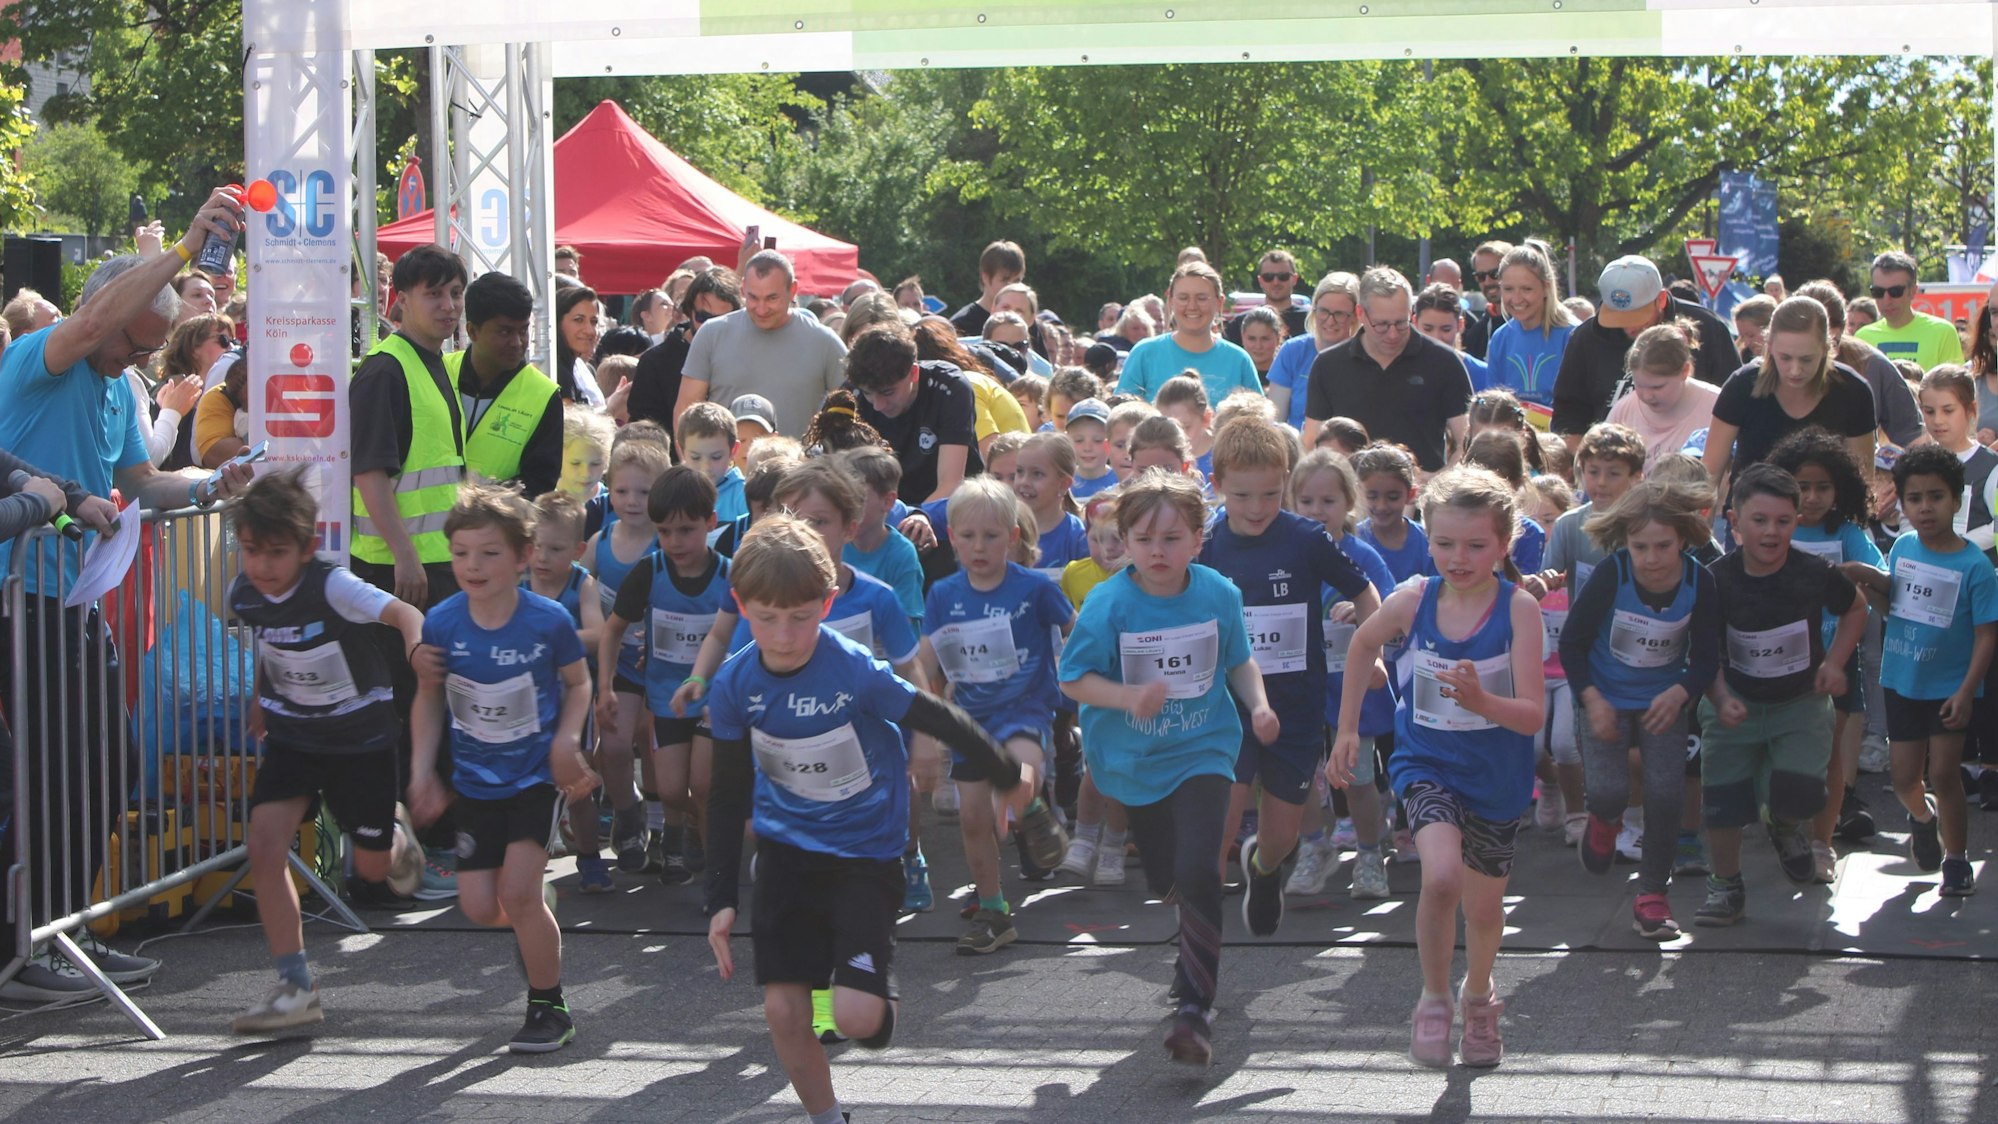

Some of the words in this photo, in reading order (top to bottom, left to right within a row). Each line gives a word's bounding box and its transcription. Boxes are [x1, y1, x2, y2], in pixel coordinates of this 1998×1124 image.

[265, 238, 297, 246] Schmidt
[303, 238, 336, 246] Clemens
[265, 316, 336, 327] Kreissparkasse
[265, 329, 288, 338] Köln
[1273, 583, 1289, 598] LB
[1905, 582, 1933, 598] 158
[676, 633, 707, 642] 507
[1636, 637, 1671, 648] 468
[960, 644, 988, 656] 474
[1750, 646, 1784, 658] 524
[1154, 654, 1192, 669] 161
[471, 704, 508, 716] 472
[783, 762, 828, 774] 528
